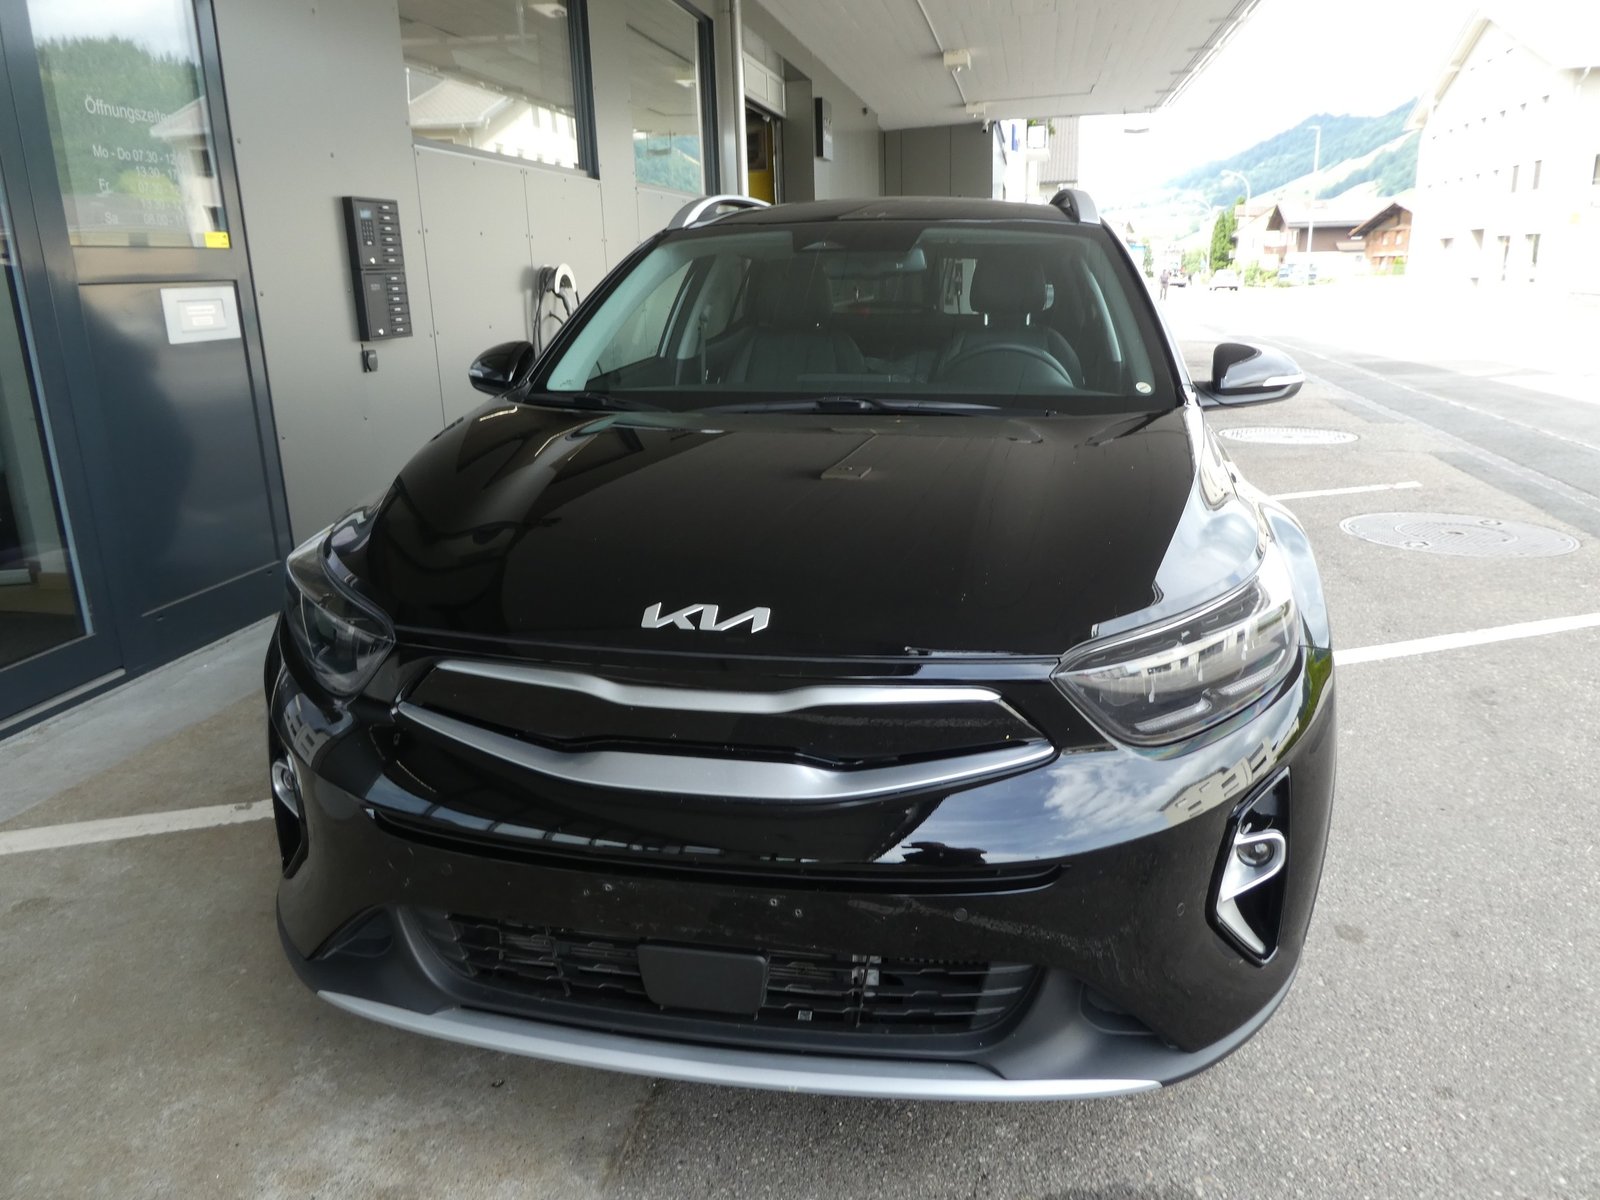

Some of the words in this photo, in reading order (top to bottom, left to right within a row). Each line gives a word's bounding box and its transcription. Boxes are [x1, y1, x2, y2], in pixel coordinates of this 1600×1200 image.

[92, 144, 109, 159] Mo
[116, 147, 131, 161] Do
[641, 602, 770, 633] KIA
